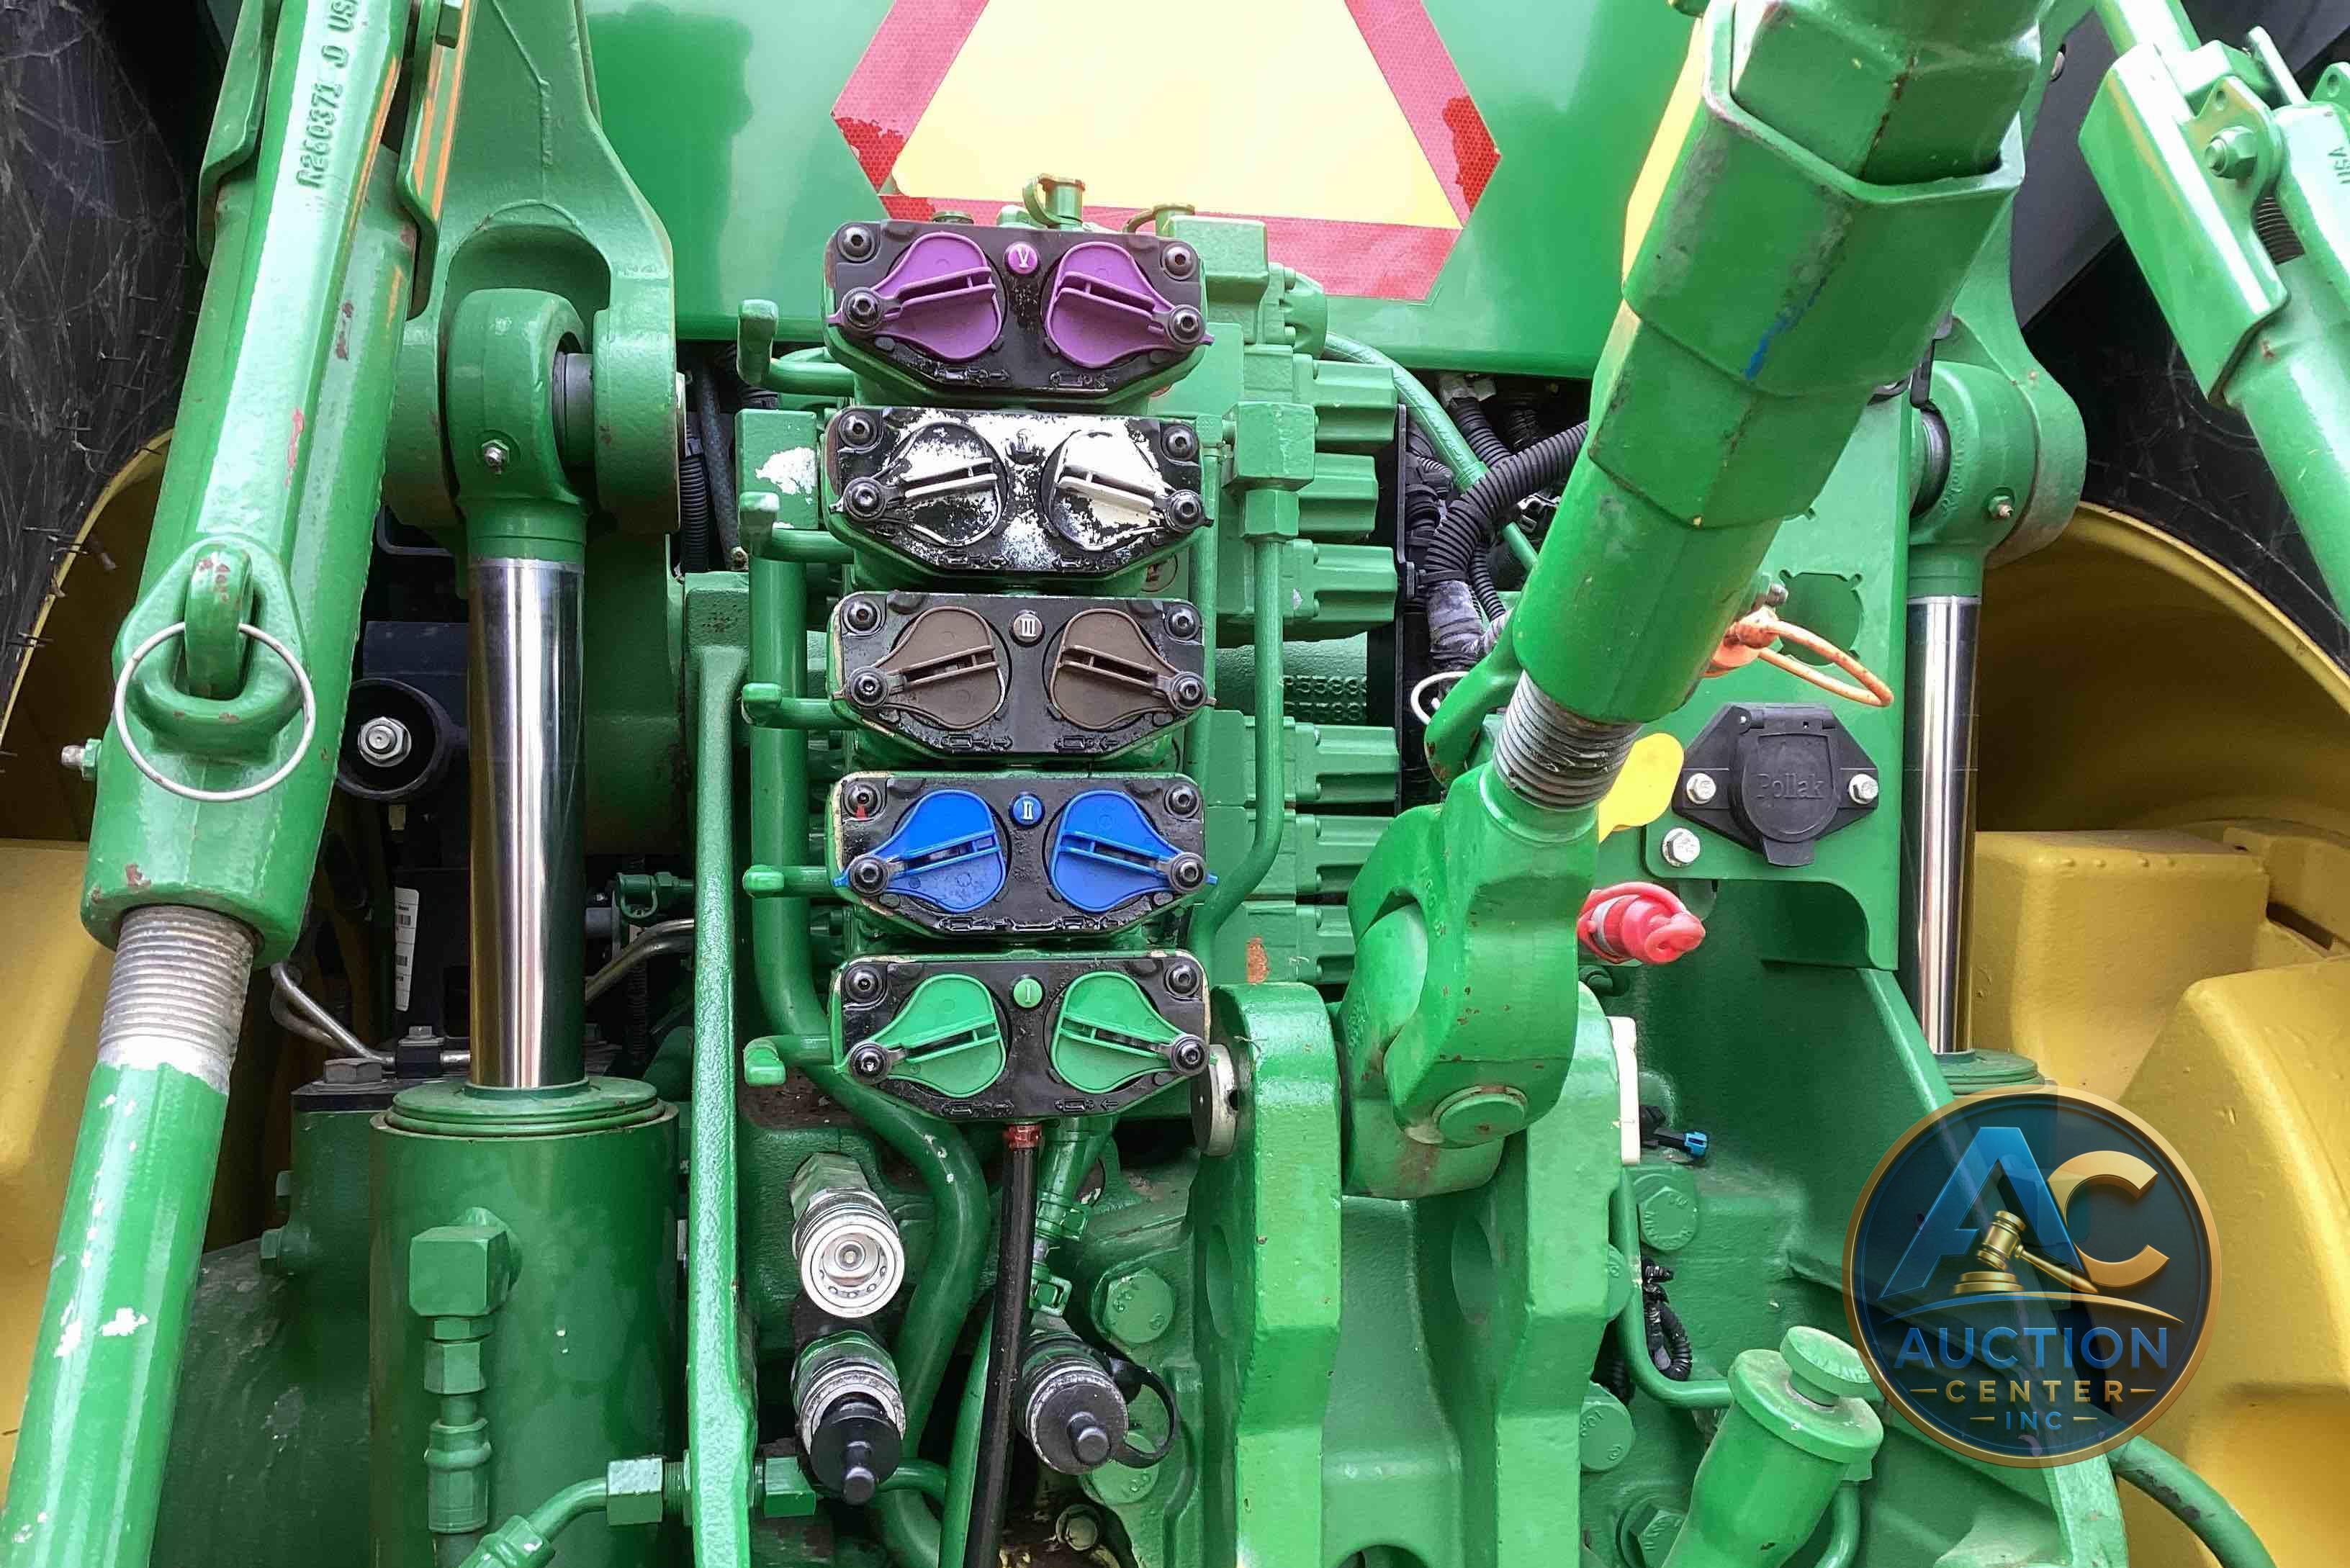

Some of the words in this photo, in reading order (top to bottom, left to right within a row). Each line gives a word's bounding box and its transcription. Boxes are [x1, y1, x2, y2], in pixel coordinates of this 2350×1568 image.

[1014, 246, 1032, 268] V
[1021, 618, 1037, 637] III
[1755, 773, 1825, 800] Pollak
[1022, 801, 1034, 820] II
